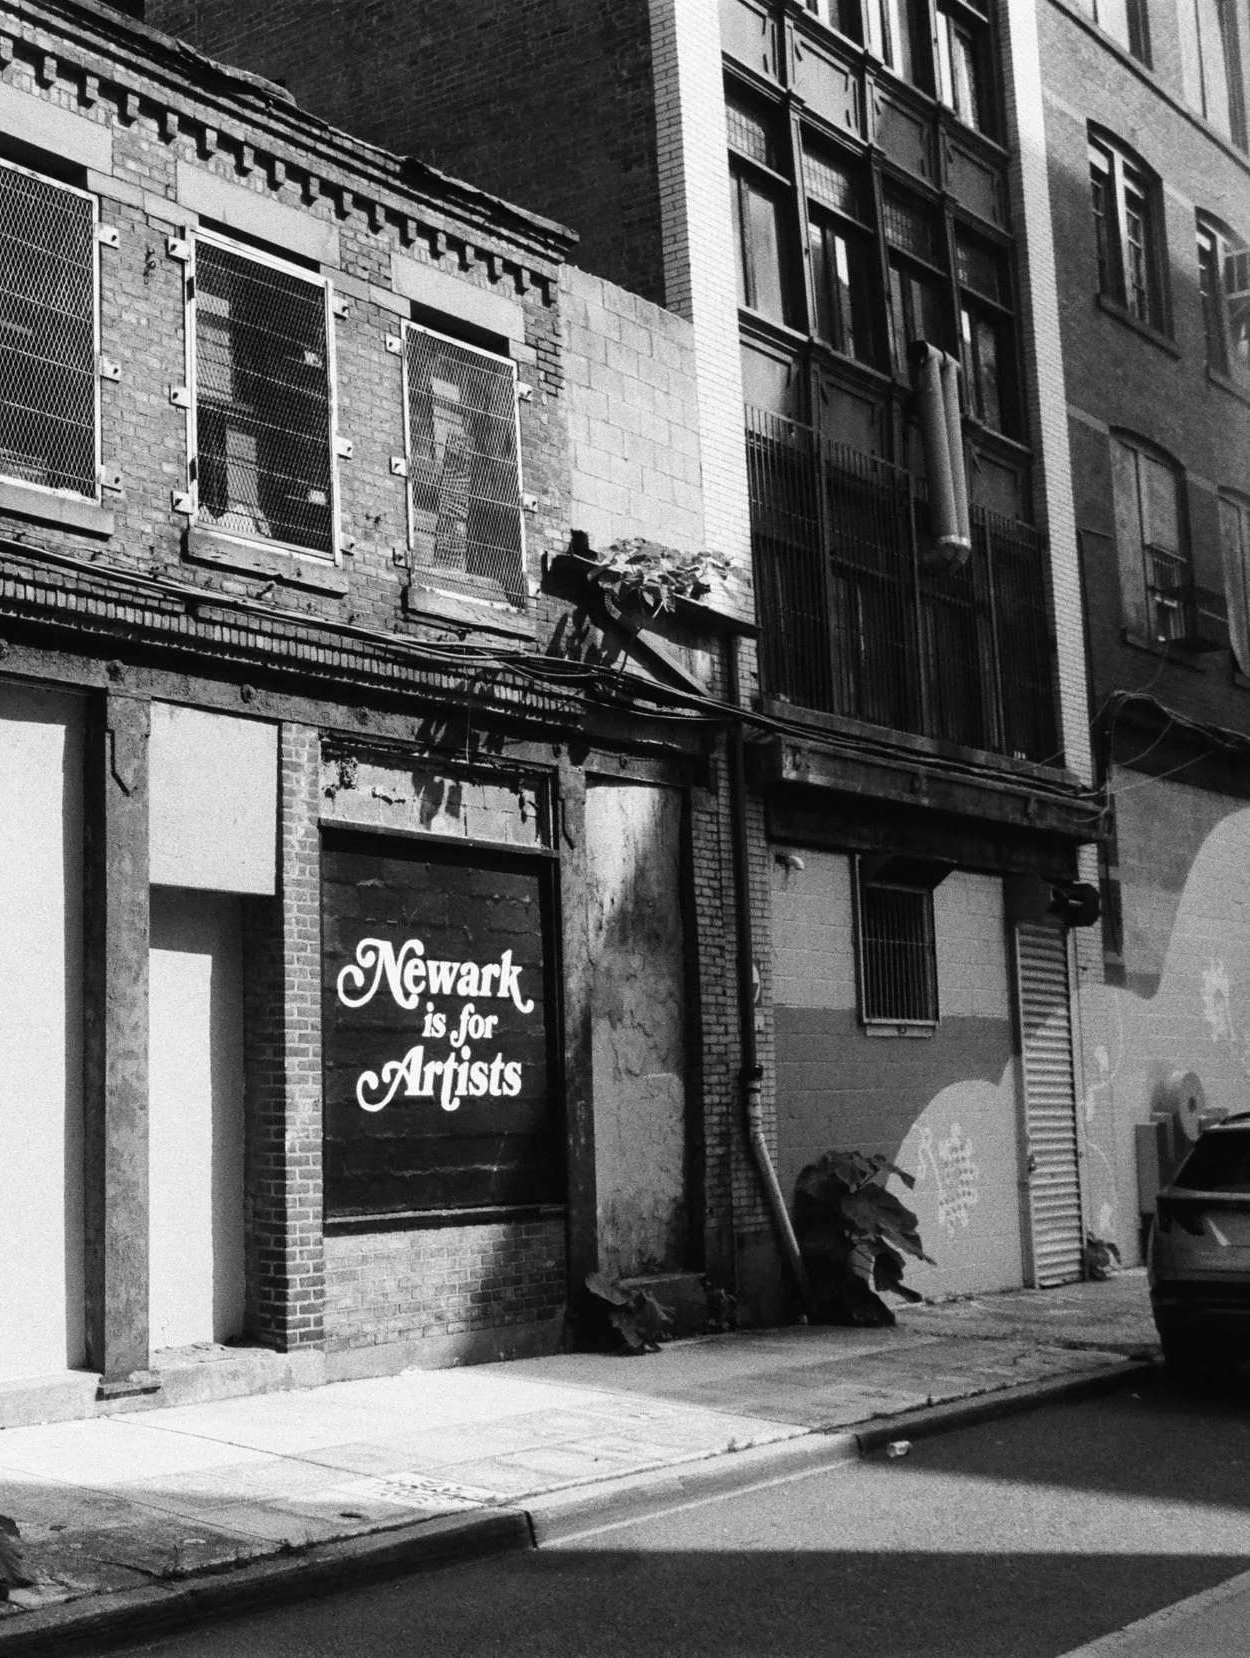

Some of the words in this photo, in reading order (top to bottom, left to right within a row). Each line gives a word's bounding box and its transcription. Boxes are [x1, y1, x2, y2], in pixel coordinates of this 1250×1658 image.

[337, 938, 534, 1013] Newark
[422, 1002, 446, 1038] is
[450, 1003, 498, 1047] for
[356, 1045, 522, 1112] Artists
